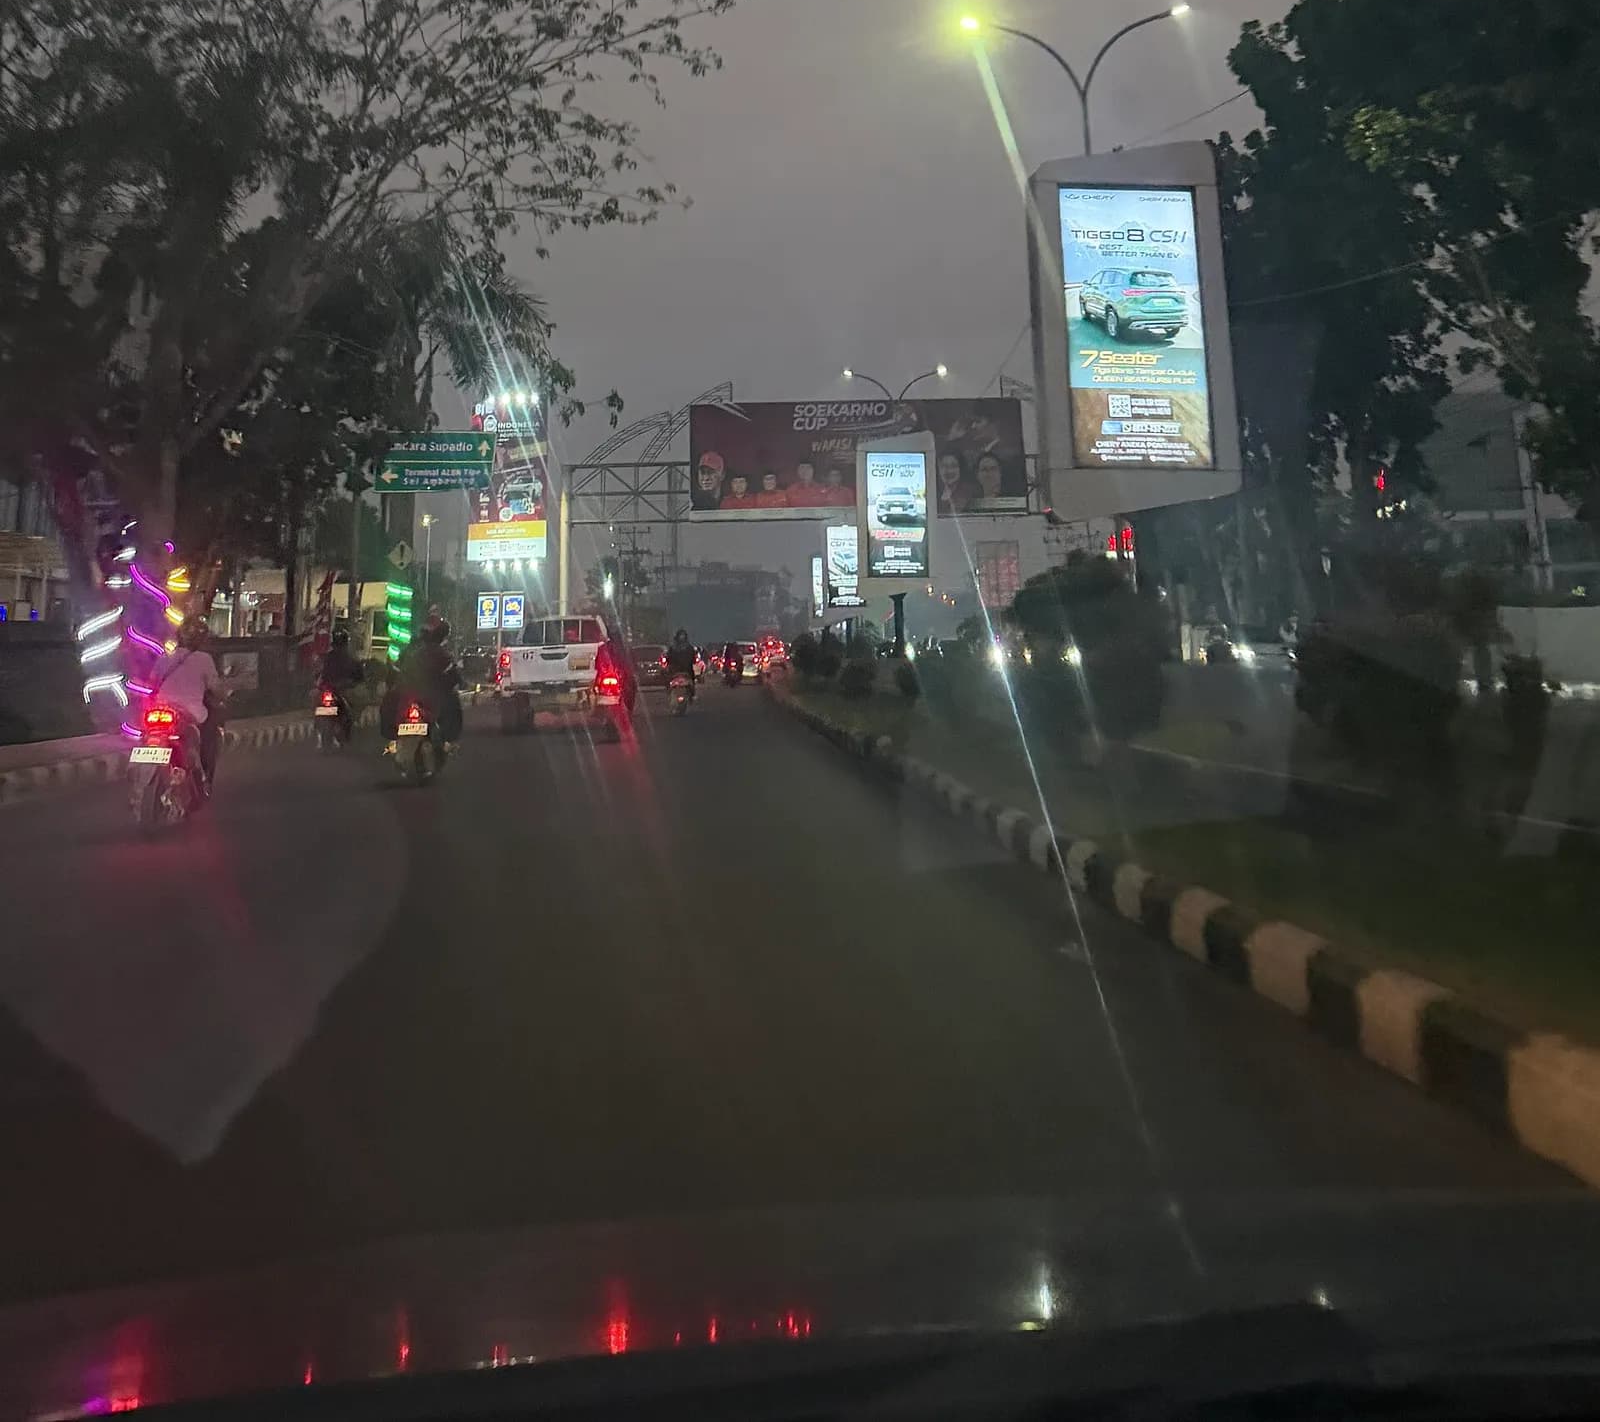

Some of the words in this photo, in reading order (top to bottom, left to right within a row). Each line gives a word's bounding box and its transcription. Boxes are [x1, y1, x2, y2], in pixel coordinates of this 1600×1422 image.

[1071, 229, 1125, 240] TIGGO
[1127, 229, 1145, 242] 8
[1140, 251, 1165, 259] THAN
[793, 403, 886, 418] SOEKARNO
[793, 417, 828, 431] CUP
[429, 441, 473, 452] Supadio
